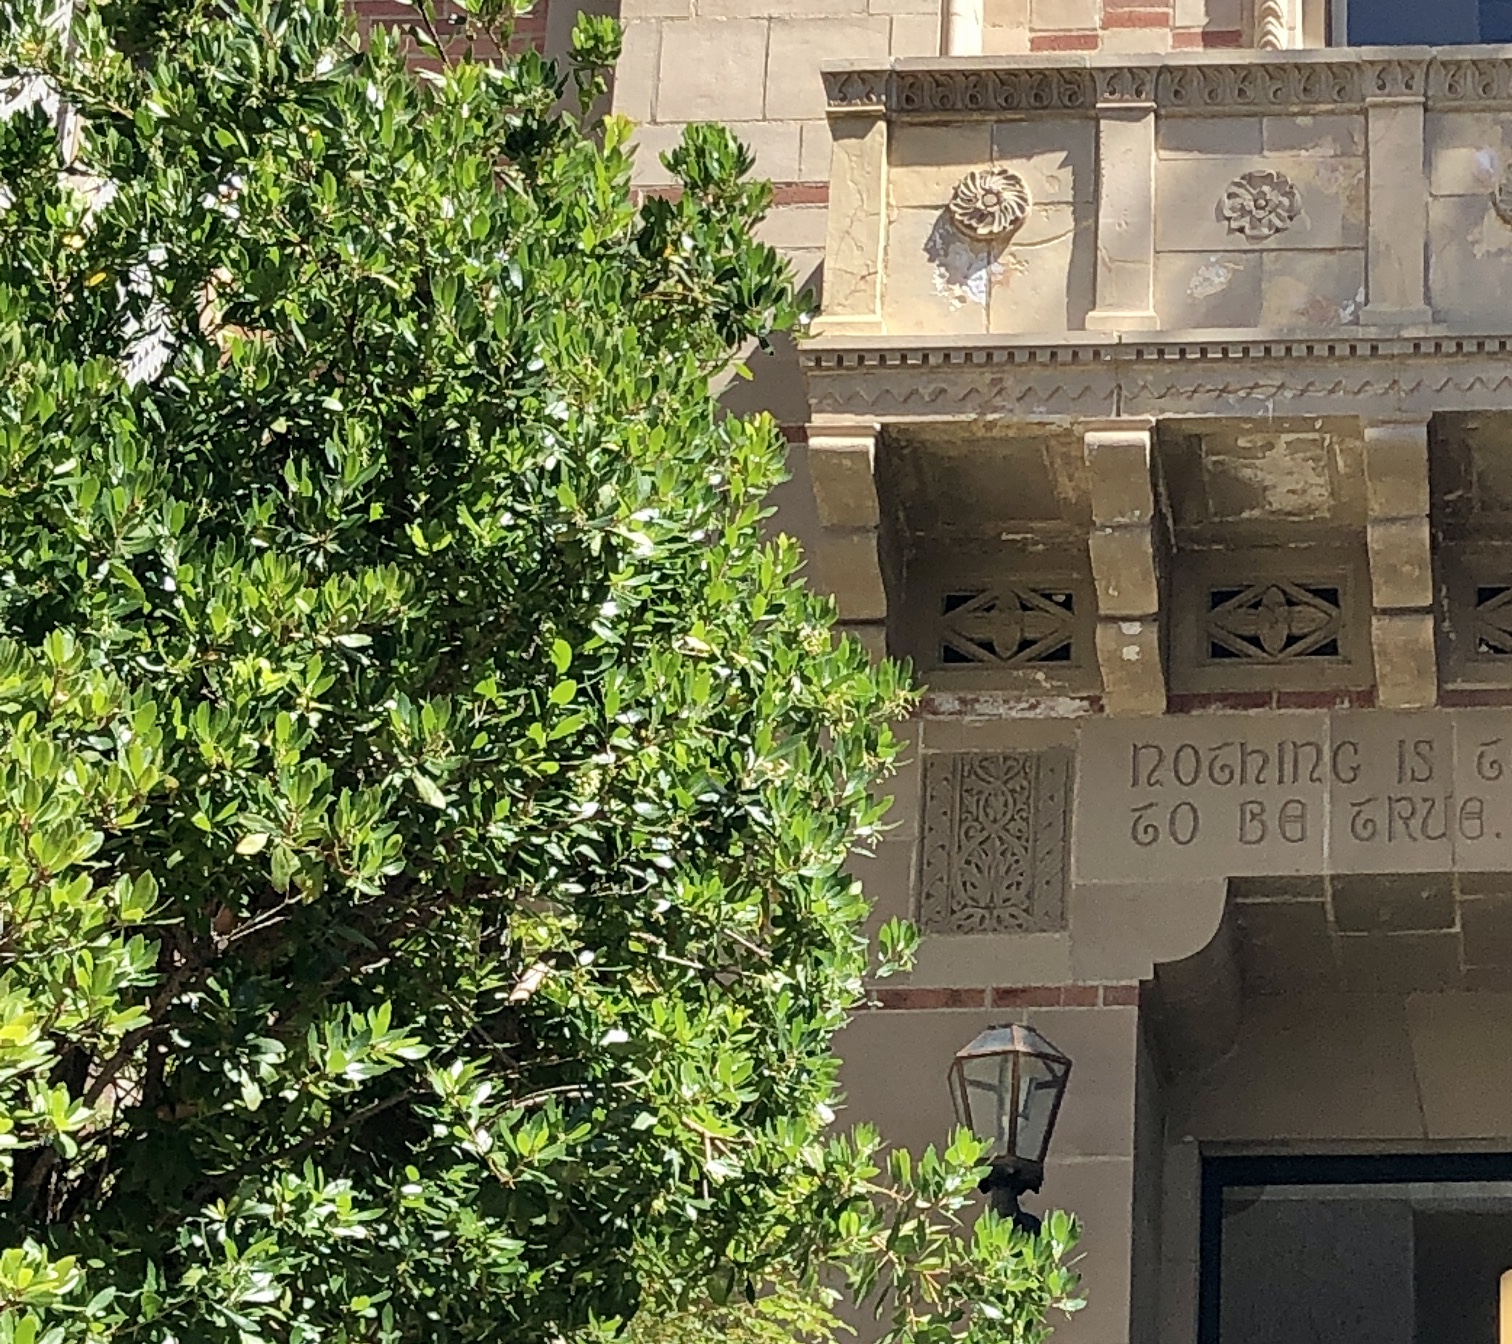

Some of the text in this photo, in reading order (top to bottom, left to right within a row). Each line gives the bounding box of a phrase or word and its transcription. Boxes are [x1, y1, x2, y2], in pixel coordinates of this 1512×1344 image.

[1131, 739, 1361, 788] NOTHING
[1397, 739, 1434, 784] IS
[1130, 801, 1200, 846] TO
[1238, 799, 1308, 845] BE
[1350, 795, 1502, 843] TRUE.
